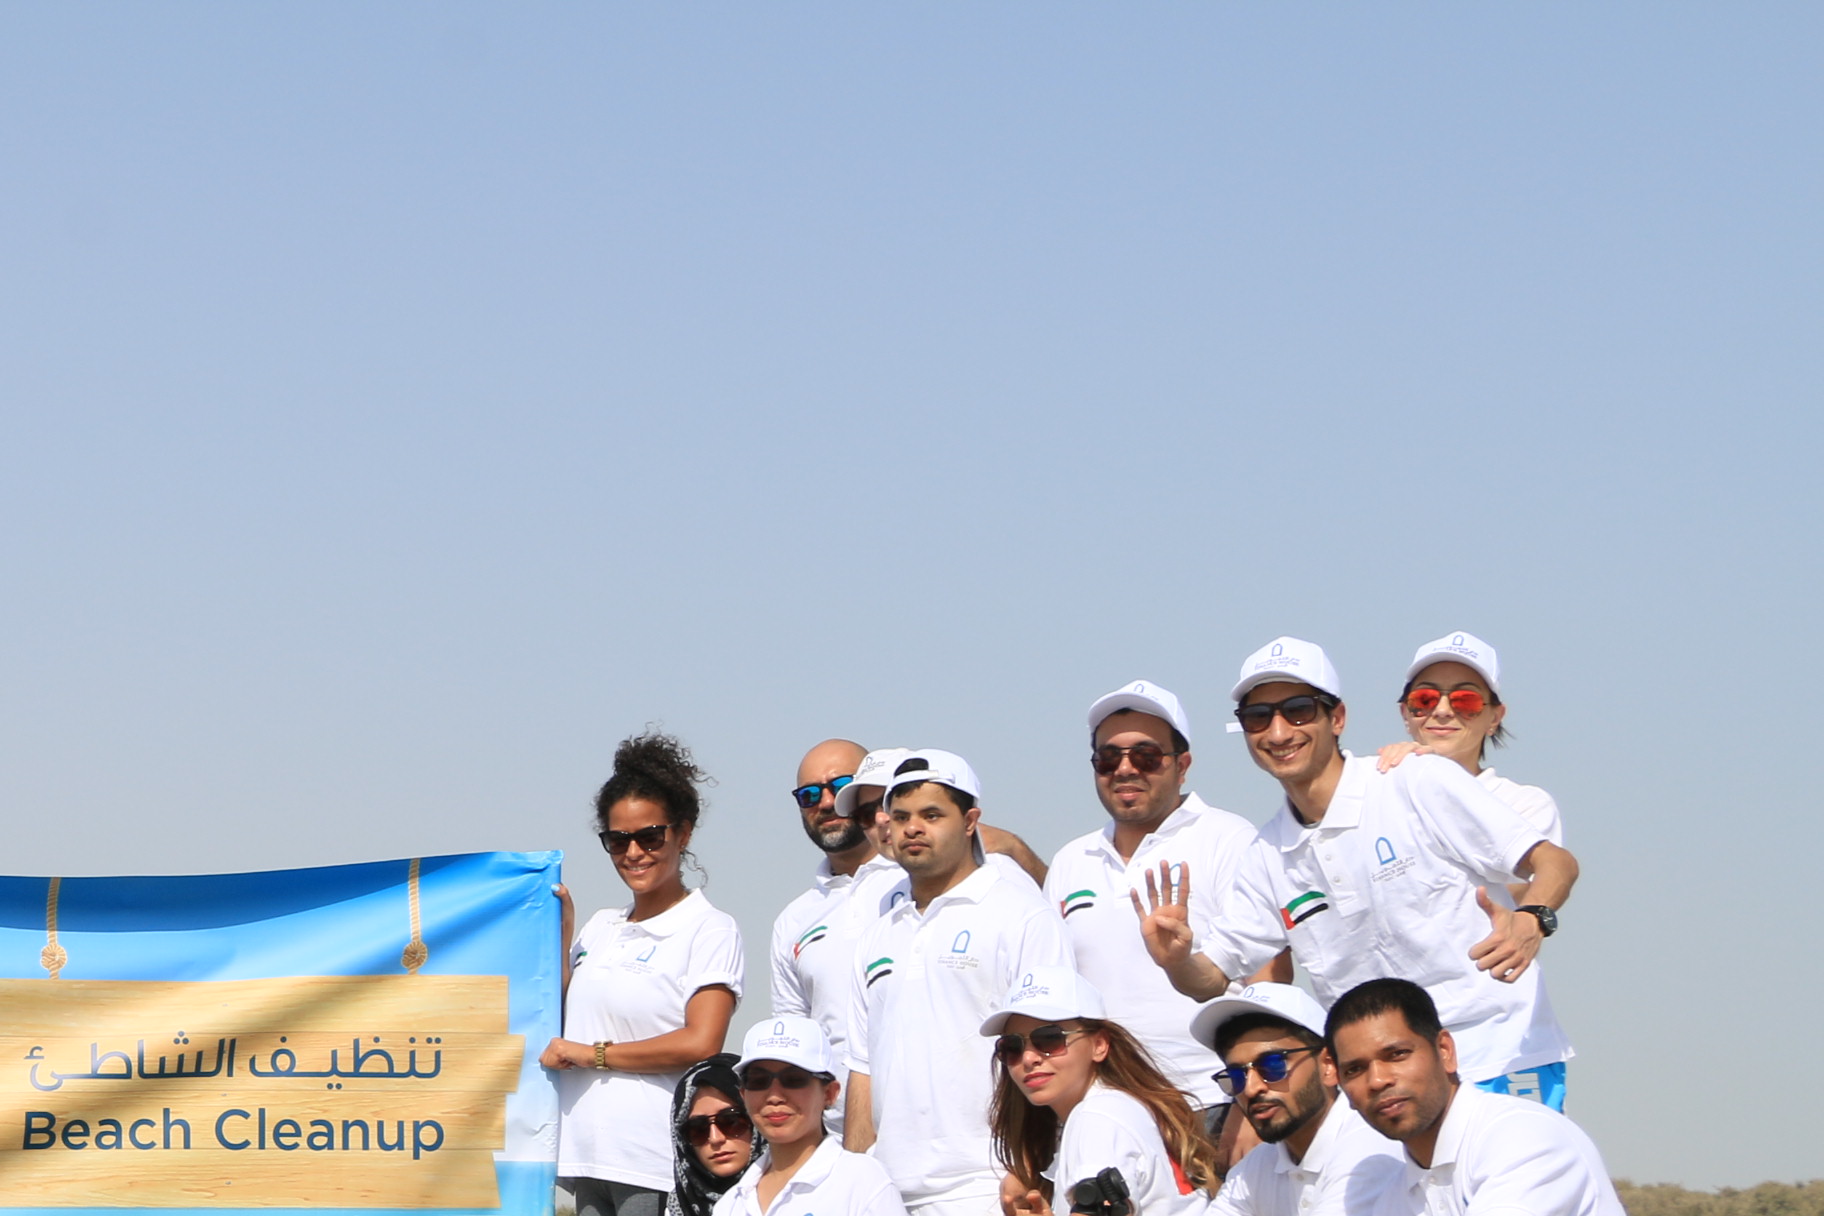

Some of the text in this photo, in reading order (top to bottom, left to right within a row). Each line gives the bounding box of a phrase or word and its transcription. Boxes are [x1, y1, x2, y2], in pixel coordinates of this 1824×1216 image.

[23, 1031, 442, 1092] تنظيف الشاطئ
[22, 1107, 445, 1160] Beach Cleanup
